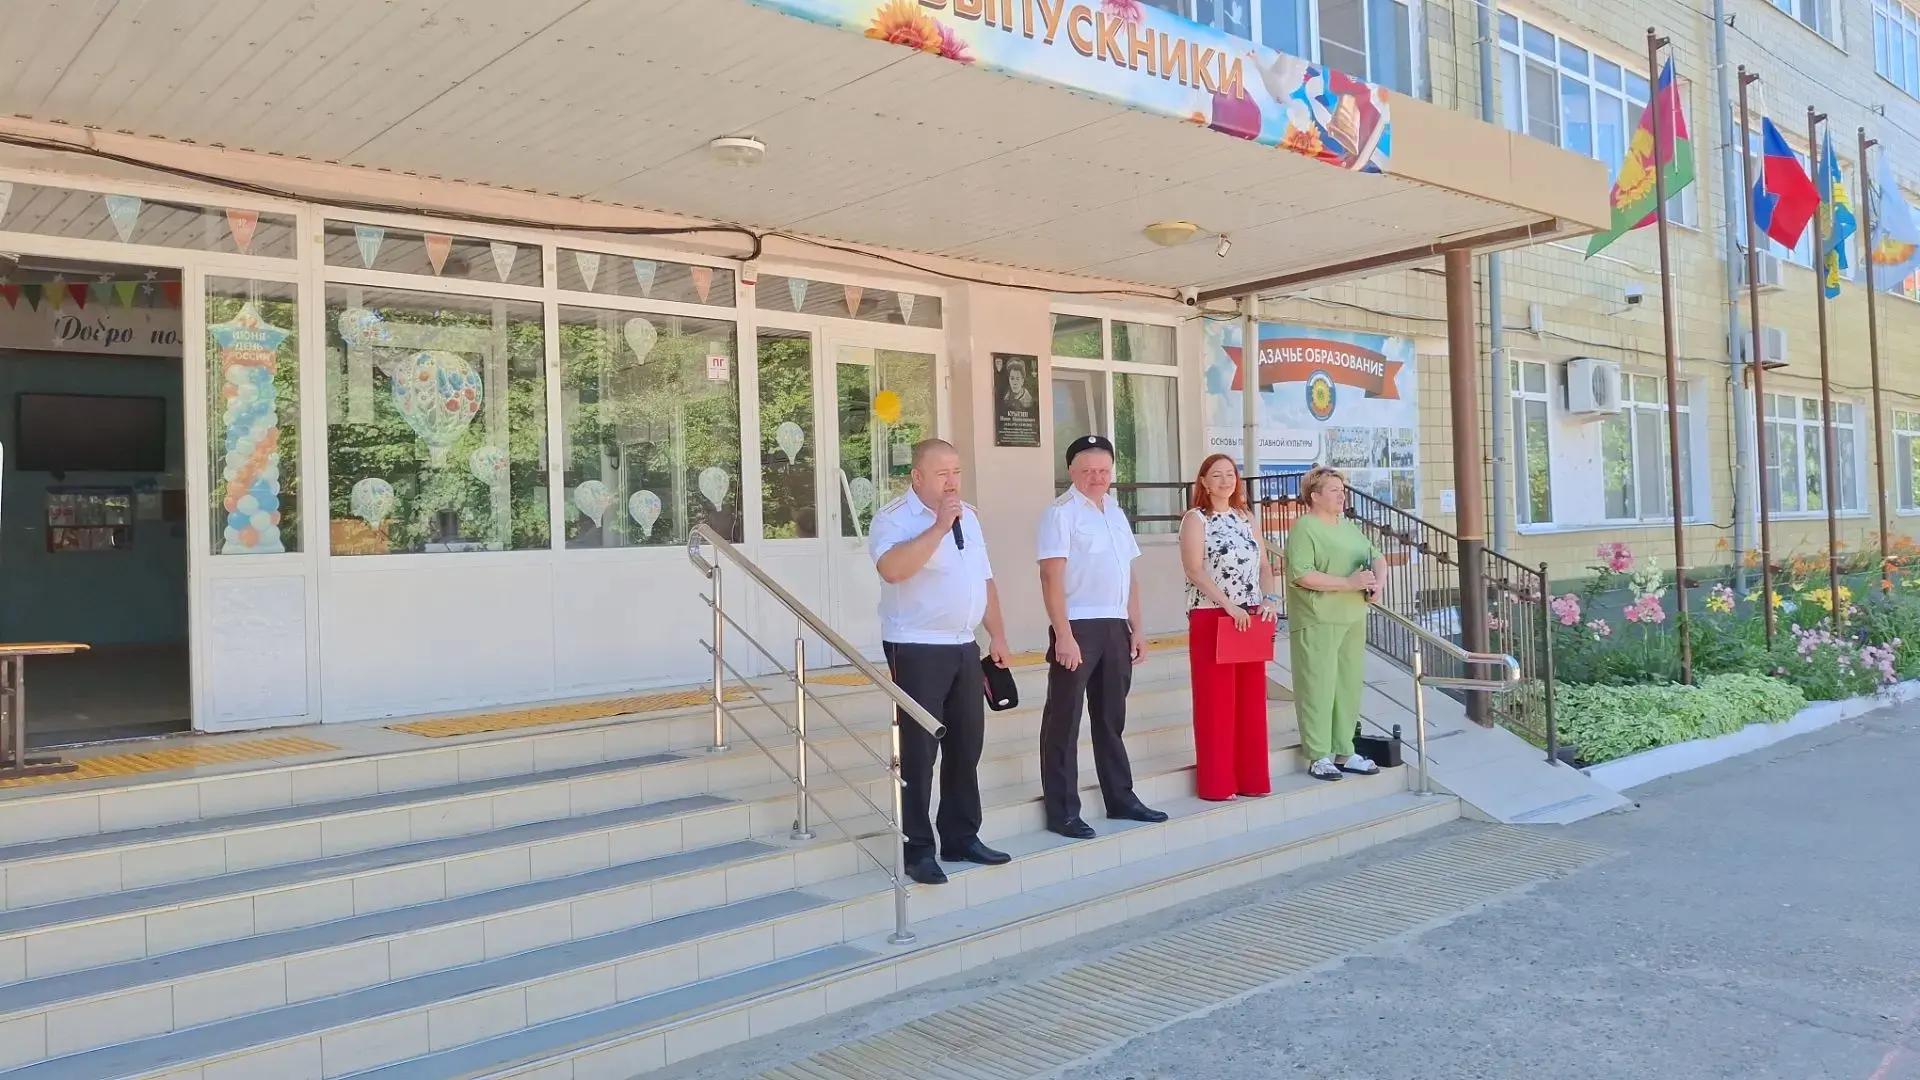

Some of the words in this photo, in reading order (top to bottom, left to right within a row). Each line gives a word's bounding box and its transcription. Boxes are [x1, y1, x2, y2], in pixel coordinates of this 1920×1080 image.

[918, 0, 1244, 99] ПУСКНИКИ
[1258, 347, 1303, 365] АЗАЧЬЕ
[1304, 347, 1385, 377] ОБРАЗОВАНИЕ
[1210, 437, 1238, 446] ОСНОВЫ
